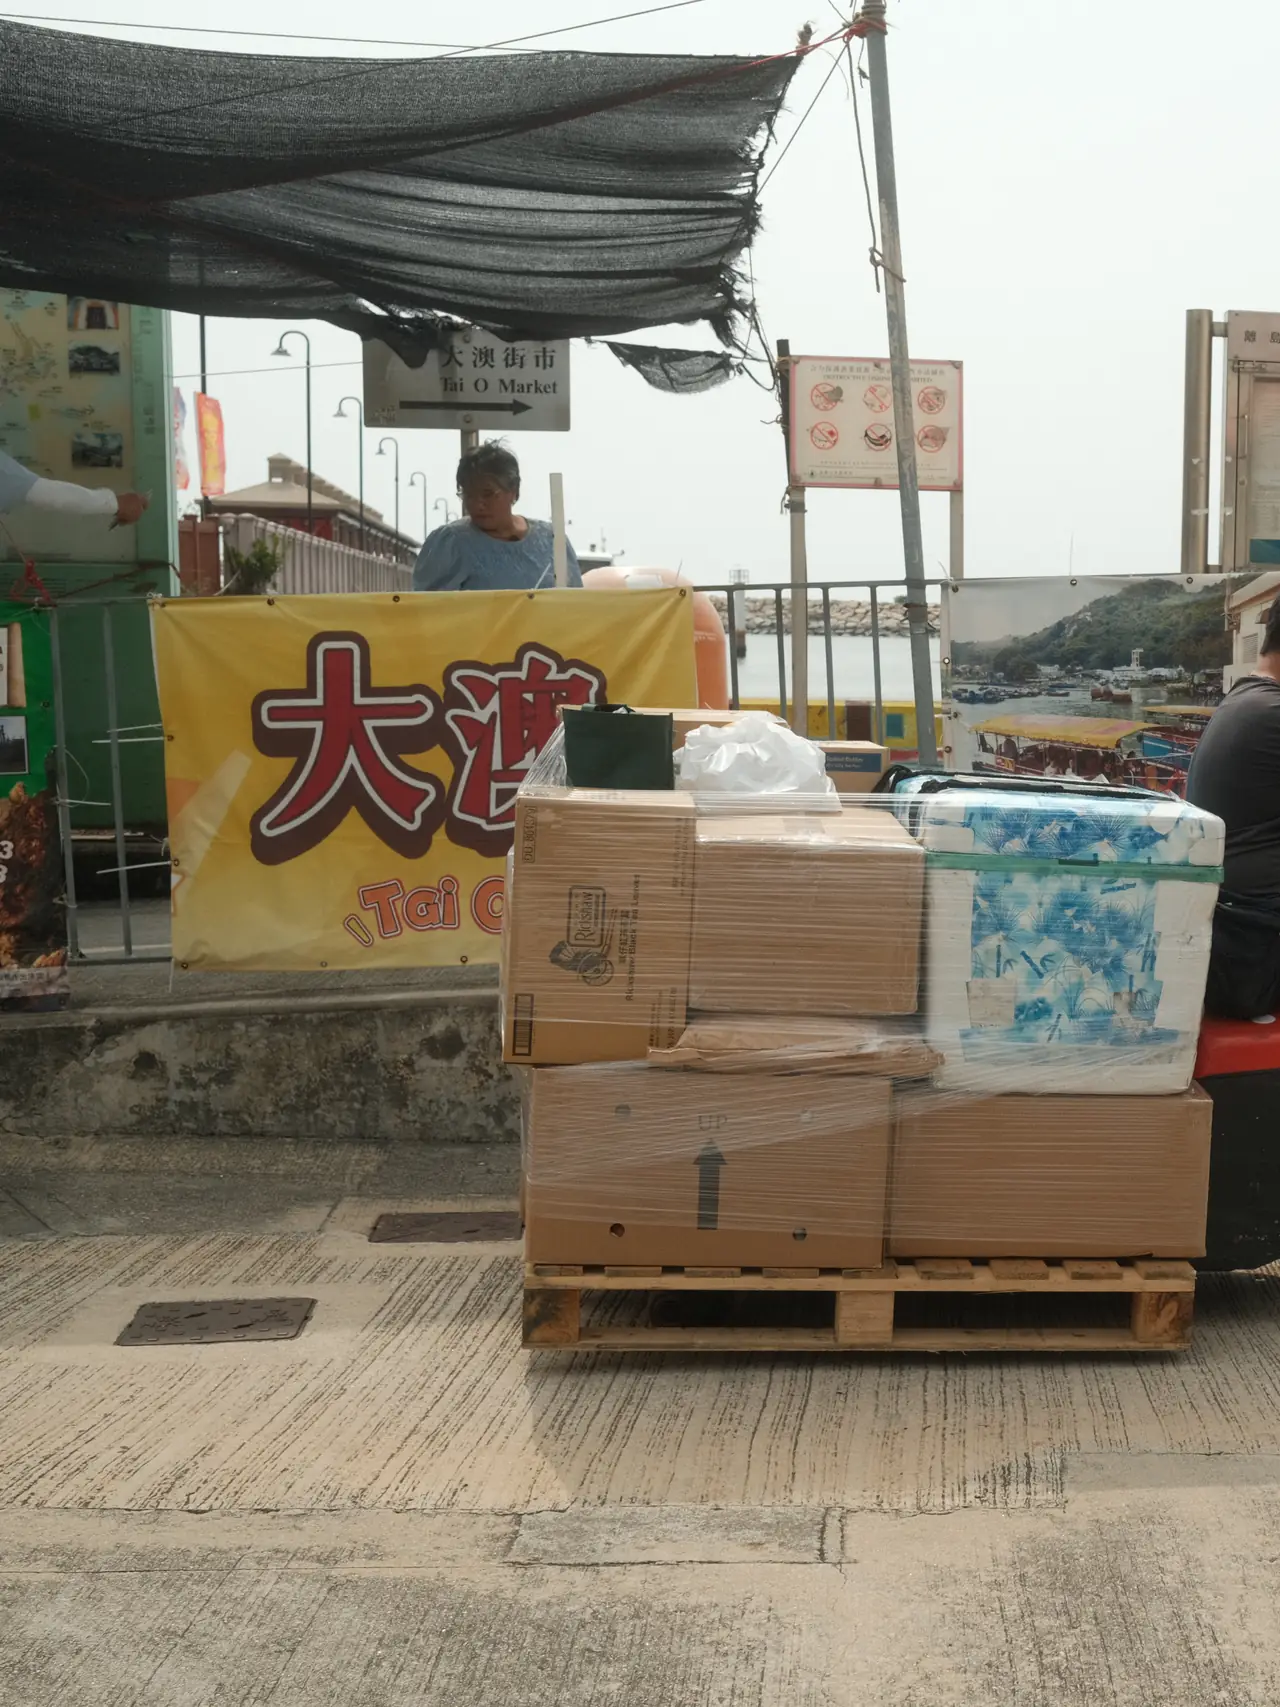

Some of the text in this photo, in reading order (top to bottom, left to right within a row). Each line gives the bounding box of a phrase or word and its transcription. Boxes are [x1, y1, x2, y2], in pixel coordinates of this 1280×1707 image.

[442, 346, 557, 370] 大澳街市
[440, 377, 557, 394] Tai O Market
[252, 632, 604, 862] 大澳
[359, 876, 460, 938] Tai
[628, 929, 638, 955] Black
